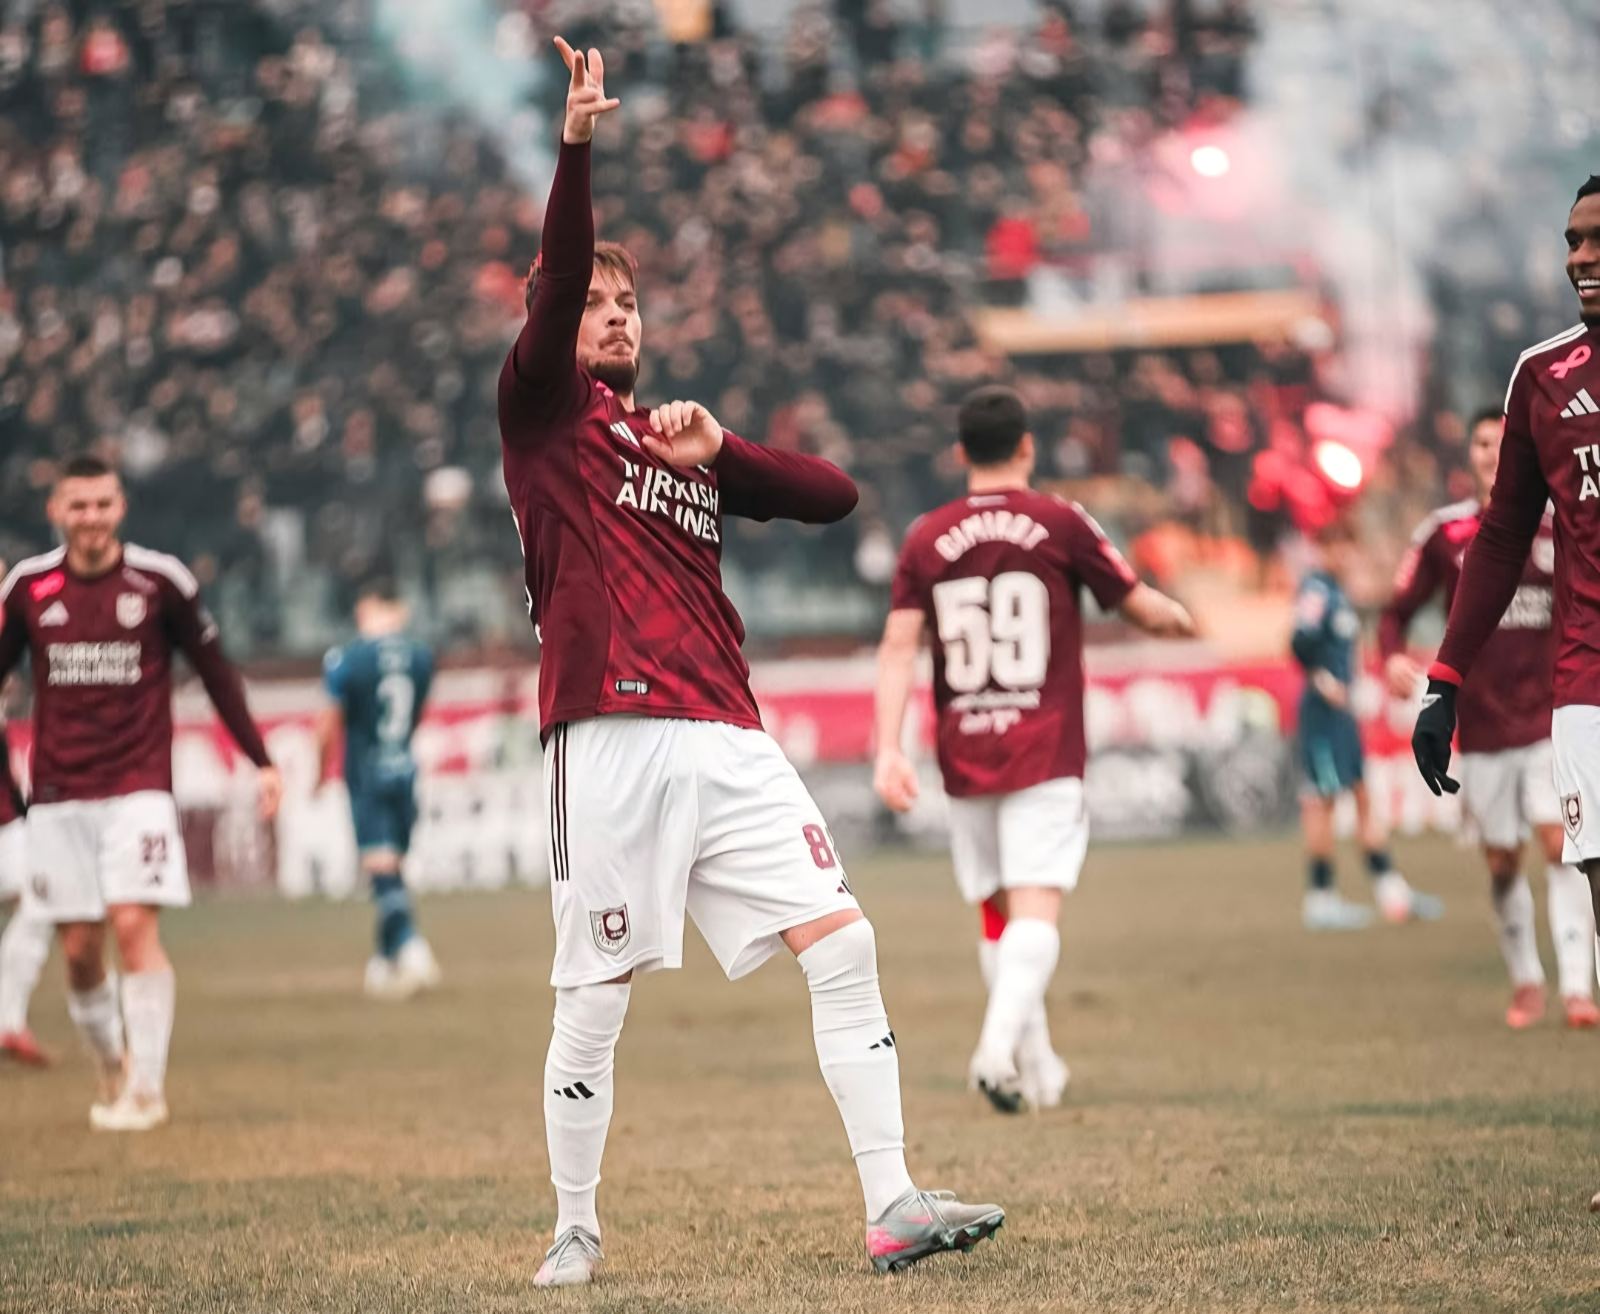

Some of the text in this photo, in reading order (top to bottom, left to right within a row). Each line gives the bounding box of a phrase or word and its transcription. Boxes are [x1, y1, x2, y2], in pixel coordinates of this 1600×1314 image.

[1579, 473, 1600, 501] A
[932, 571, 1050, 693] 59
[802, 823, 836, 870] 8
